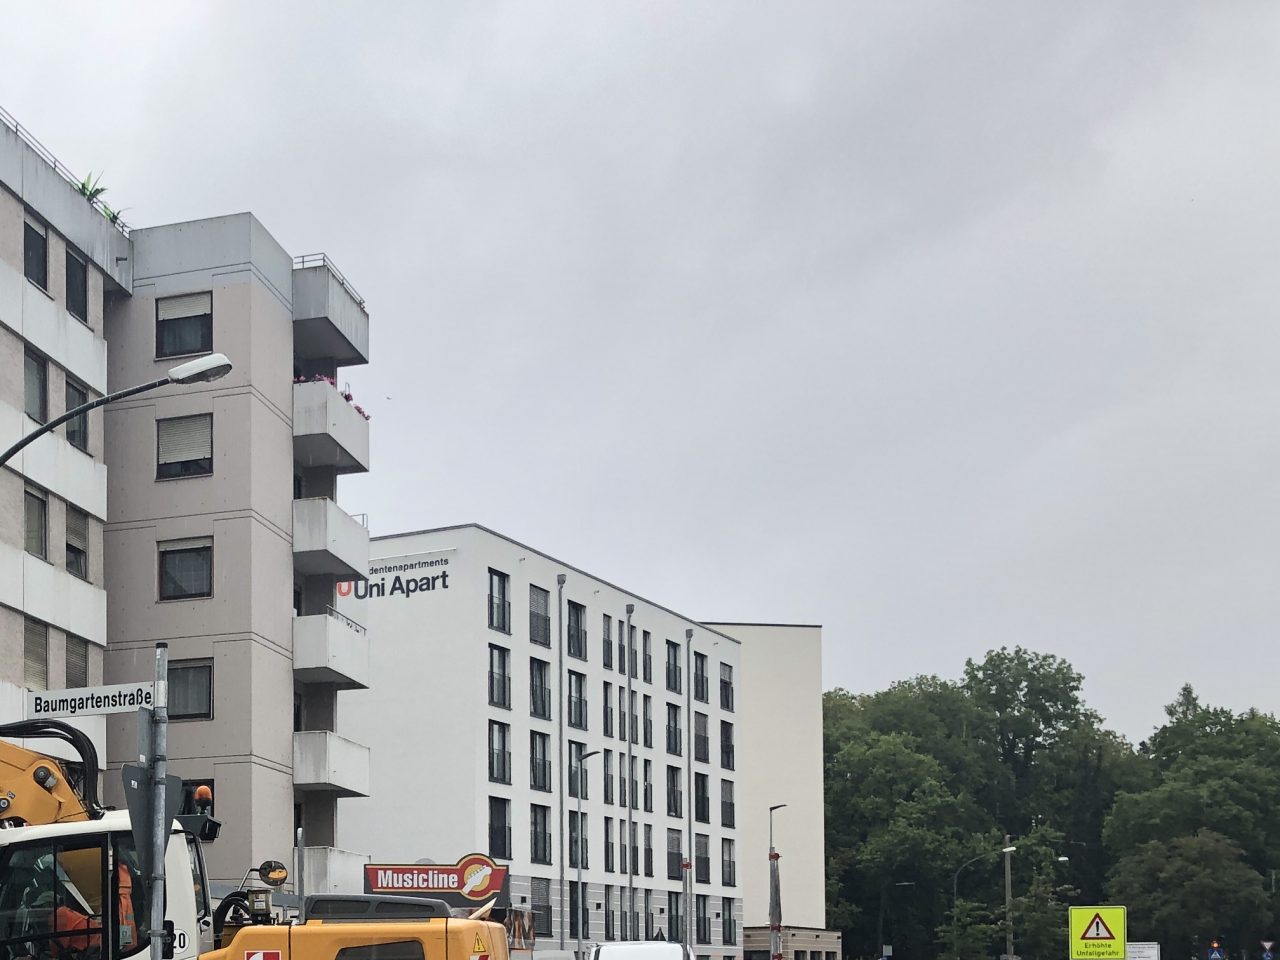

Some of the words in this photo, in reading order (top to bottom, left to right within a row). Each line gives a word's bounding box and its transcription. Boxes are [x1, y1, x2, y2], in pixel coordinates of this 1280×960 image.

[368, 557, 449, 575] dentenapartments
[354, 577, 385, 600] Uni
[389, 570, 449, 598] Apart
[34, 687, 152, 714] Baumgartenstraße
[377, 869, 458, 889] Musicline
[1076, 949, 1120, 957] Unfallgefahr
[1084, 941, 1112, 949] Erhöhte
